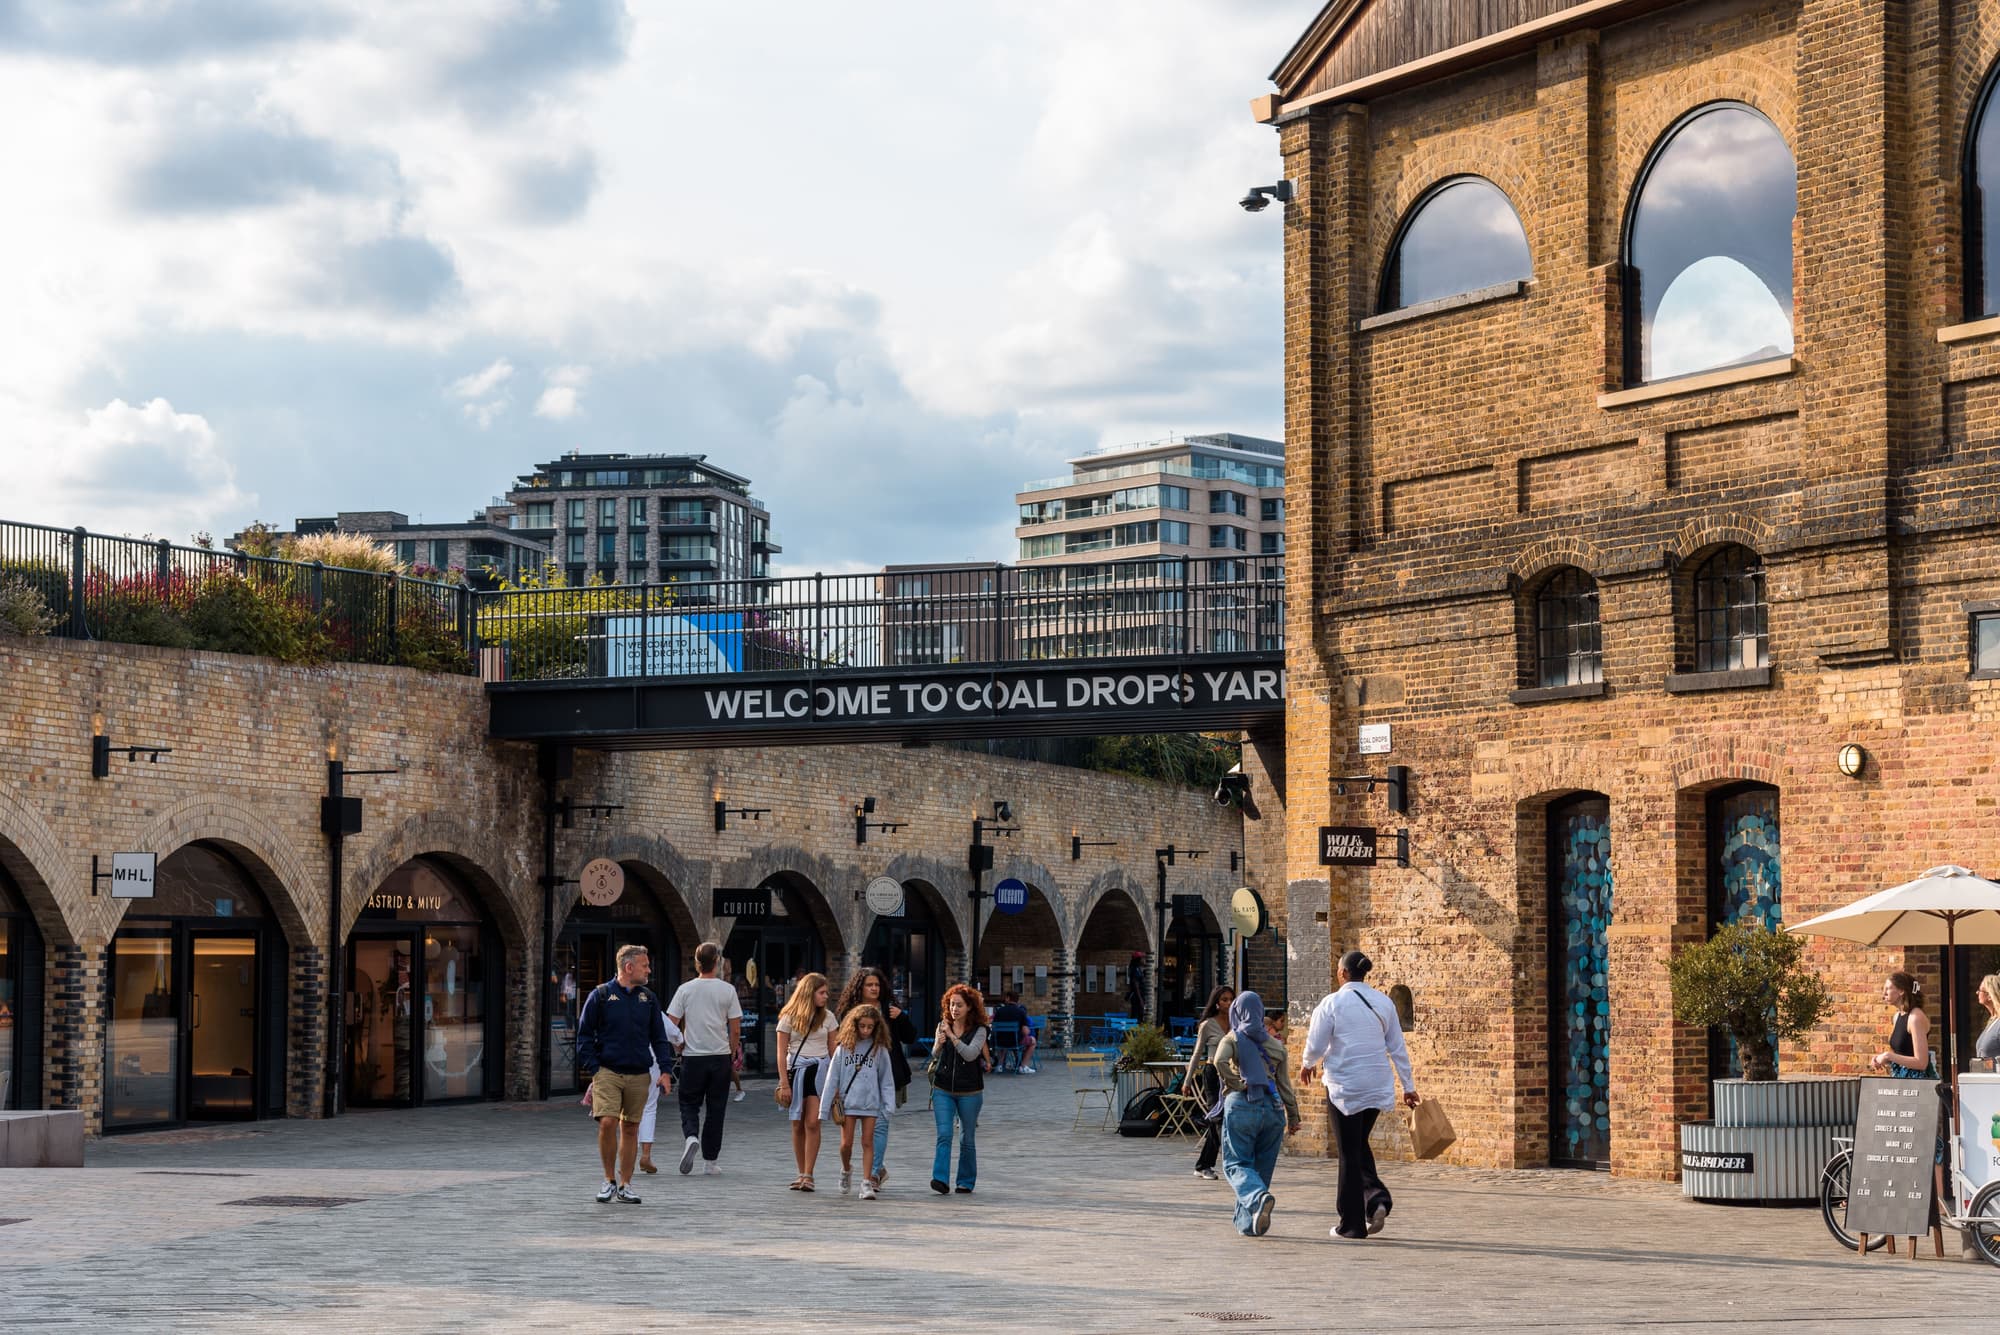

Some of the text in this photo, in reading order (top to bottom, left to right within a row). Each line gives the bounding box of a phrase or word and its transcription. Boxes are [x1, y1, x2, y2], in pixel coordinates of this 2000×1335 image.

[627, 640, 673, 649] WECOME
[704, 669, 1286, 719] WELCOME TO COAL DROPS YAR
[1326, 846, 1373, 858] BADGER
[114, 868, 152, 882] MHL.
[589, 863, 617, 877] ASTRID
[590, 889, 615, 900] MIYU
[367, 894, 441, 910] ASTRID & MIYU
[723, 902, 765, 915] CUBITTS
[845, 1053, 873, 1068] OXFORD
[1902, 1089, 1919, 1097] GELATO
[1866, 1154, 1889, 1162] CHOCOLATE
[1895, 1155, 1918, 1164] HAZELNUT
